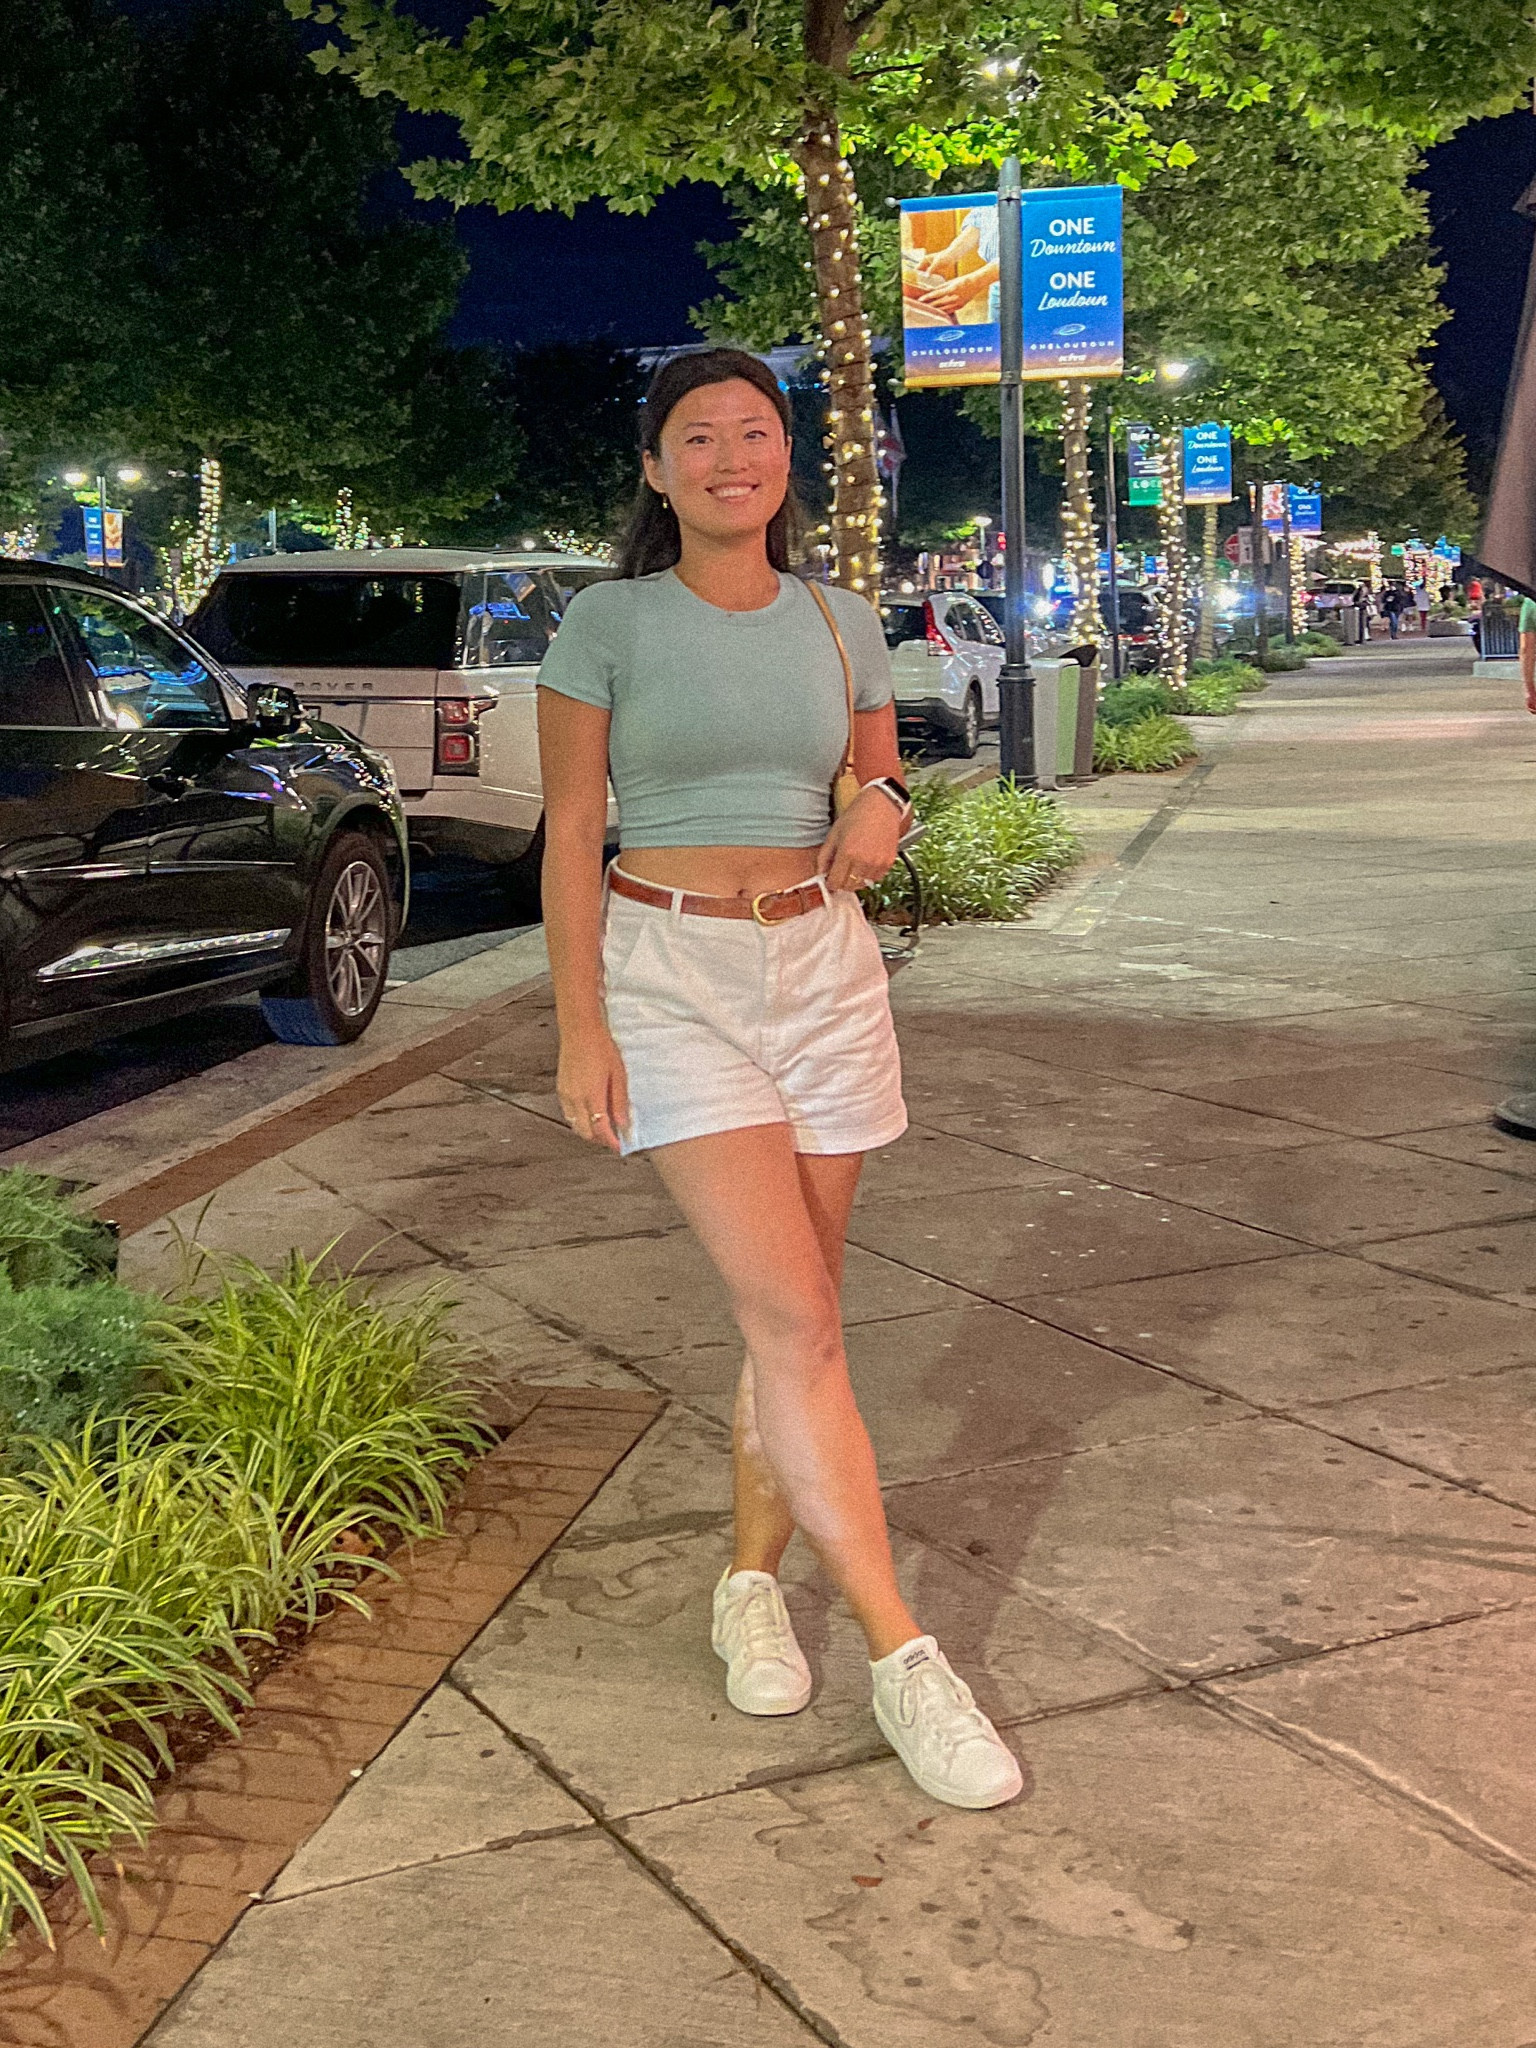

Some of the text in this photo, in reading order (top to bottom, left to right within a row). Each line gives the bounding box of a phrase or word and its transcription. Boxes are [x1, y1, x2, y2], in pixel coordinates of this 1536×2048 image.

[1048, 217, 1096, 237] ONE
[1030, 238, 1116, 258] Downtown
[1049, 270, 1096, 290] ONE
[1037, 290, 1108, 311] Loudoun
[1196, 431, 1218, 441] ONE
[1196, 455, 1218, 464] ONE
[293, 682, 373, 691] ROVER
